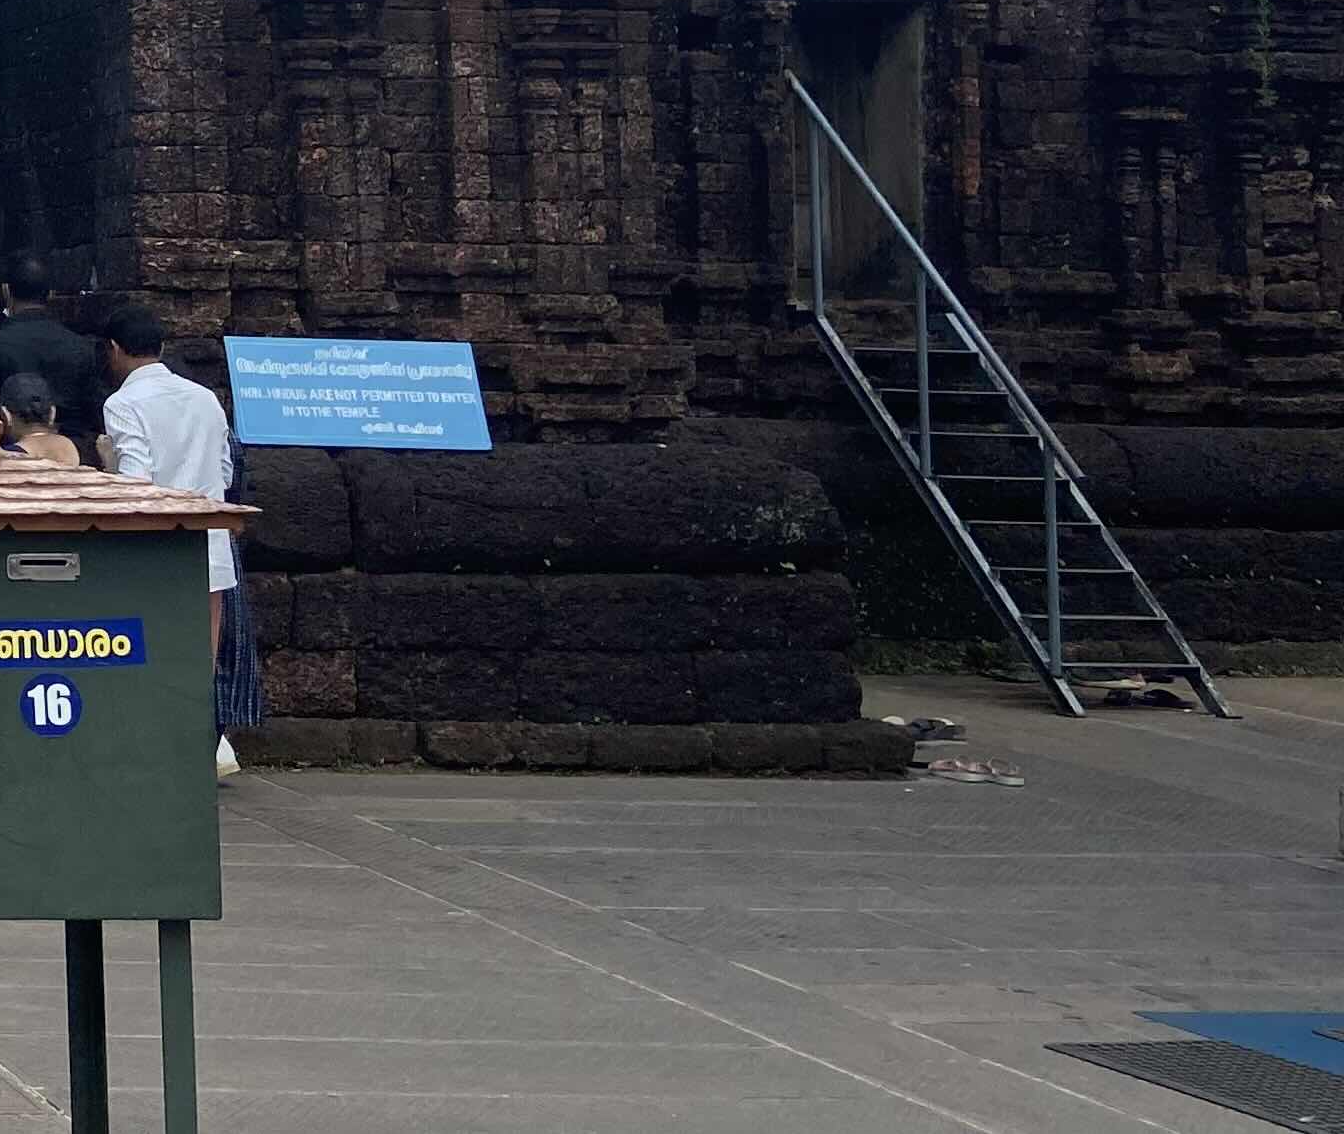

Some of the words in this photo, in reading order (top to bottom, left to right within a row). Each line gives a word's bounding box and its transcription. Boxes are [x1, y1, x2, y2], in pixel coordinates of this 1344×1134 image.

[308, 388, 334, 402] ARE
[335, 389, 357, 403] NOT
[362, 389, 424, 403] PERMITTED
[424, 391, 439, 404] TO
[440, 391, 476, 404] ENTER
[309, 406, 334, 418] THE
[335, 406, 382, 419] TEMPLE
[26, 683, 72, 727] 16
